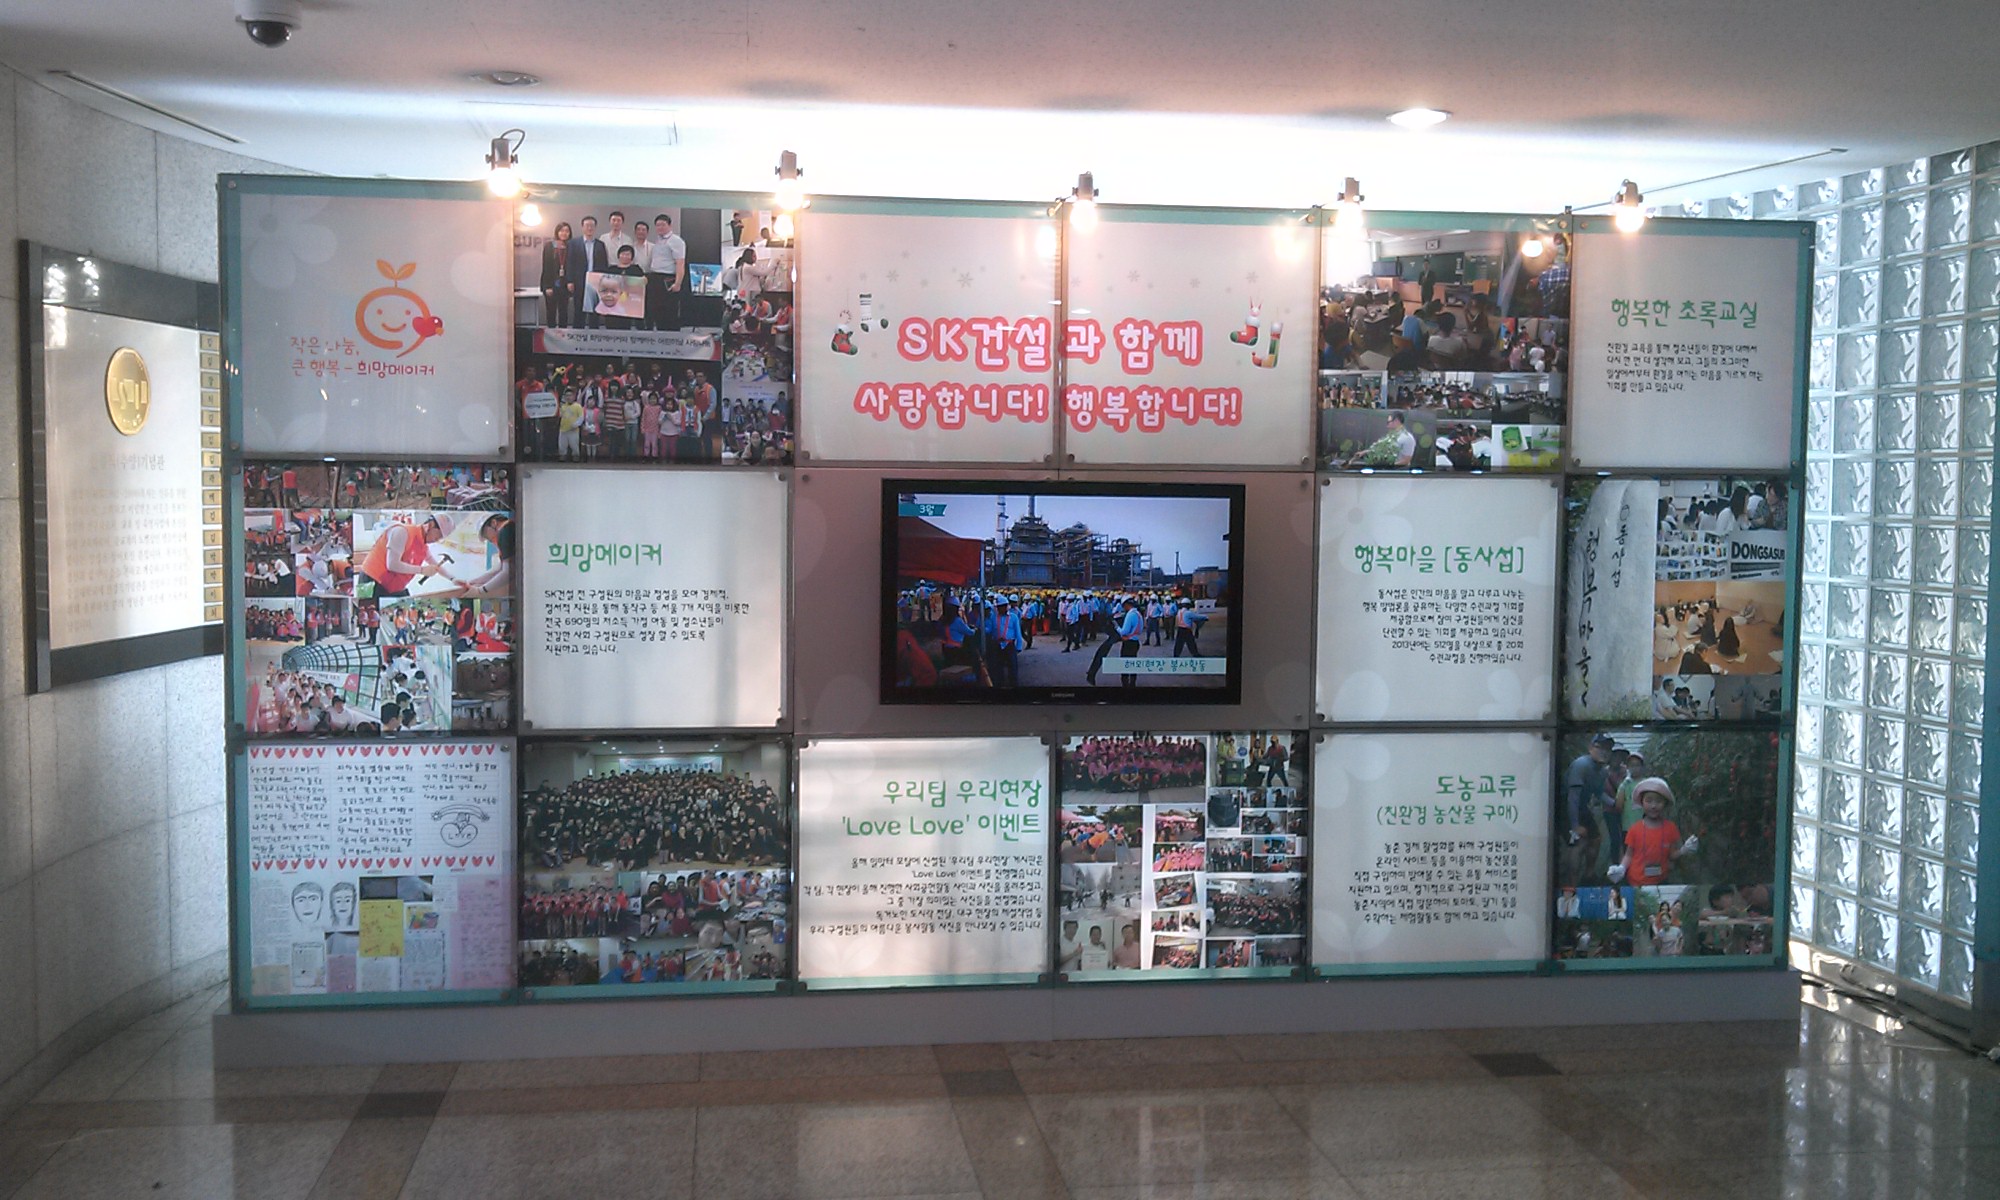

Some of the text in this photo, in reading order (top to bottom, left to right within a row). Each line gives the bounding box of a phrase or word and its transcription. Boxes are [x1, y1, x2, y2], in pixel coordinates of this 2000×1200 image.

[1612, 298, 1757, 328] 행복한 초록교실
[290, 337, 320, 355] 작은
[1119, 320, 1198, 369] 함께
[293, 360, 434, 378] 큰 행복 희망메이커
[1607, 356, 1621, 364] 다시
[859, 386, 1239, 427] 사랑합니다! 행복합니다!
[919, 505, 934, 515] 3월
[548, 543, 661, 573] 희망메이커
[1355, 545, 1523, 573] 행복마을 [동사섭]
[545, 589, 698, 601] SK건설 전 구성원의 마음과 정성을 모아
[1410, 589, 1433, 599] 인간의
[1435, 589, 1457, 600] 마음을
[546, 604, 570, 615] 정서적
[574, 603, 598, 614] 지원을
[603, 604, 619, 614] 통해
[622, 603, 647, 614] 동작구
[650, 603, 658, 614] 등
[662, 603, 677, 614] 서울
[697, 603, 721, 614] 지역을
[725, 603, 749, 614] 비롯한
[545, 617, 561, 628] 전국
[565, 617, 599, 628] 690명의
[604, 617, 628, 627] 저소득
[632, 617, 647, 628] 가정
[651, 617, 667, 628] 아동
[682, 617, 723, 628] 청소년들이
[545, 631, 570, 642] 건강한
[574, 631, 590, 639] 사회
[594, 631, 635, 642] 구성원으로
[639, 631, 655, 641] 성장
[670, 631, 677, 639] 수
[681, 631, 705, 641] 있도록
[1408, 628, 1414, 636] 수
[546, 645, 579, 656] 지원하고
[1124, 658, 1207, 673] 해외현장 봉사활동
[883, 780, 1042, 808] 우리팀 우리현장
[1436, 775, 1517, 802] 도농교류
[1377, 805, 1518, 825] (친환경 농산물 구매)
[843, 814, 1041, 841] 'Love Love' 이벤트
